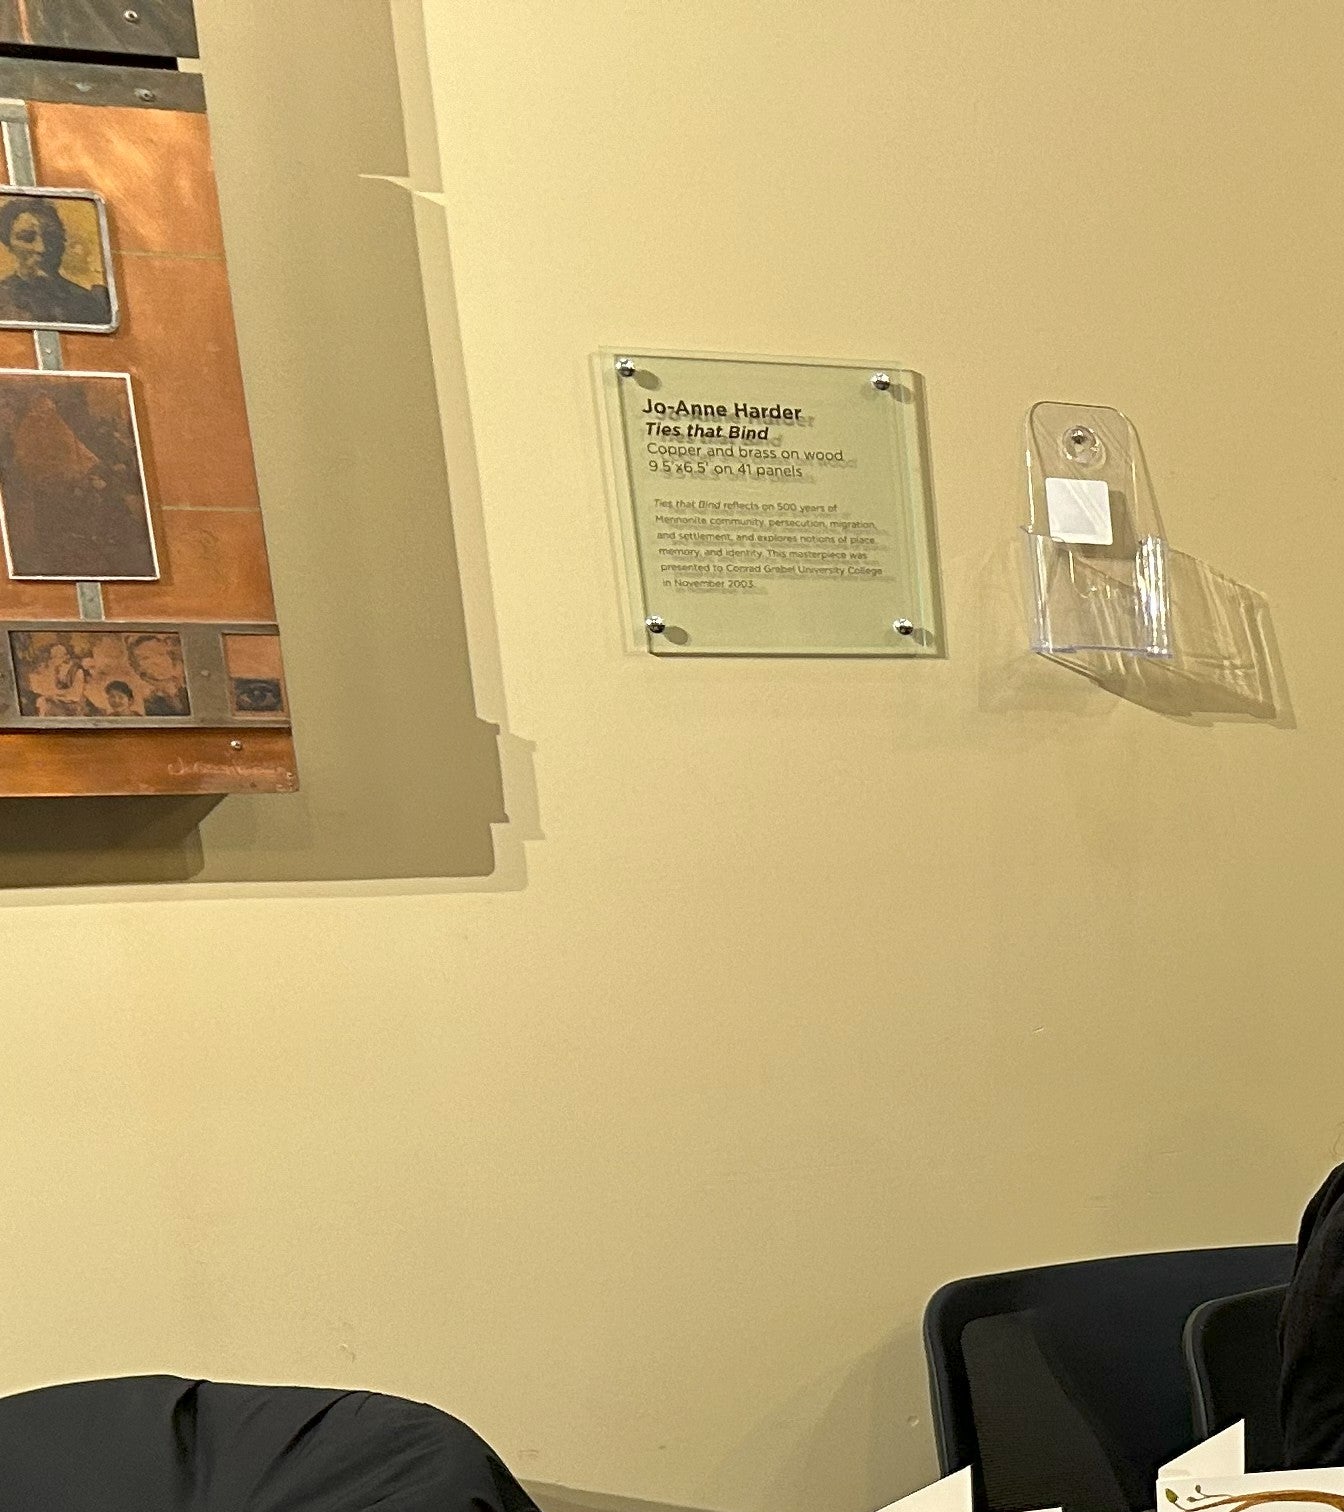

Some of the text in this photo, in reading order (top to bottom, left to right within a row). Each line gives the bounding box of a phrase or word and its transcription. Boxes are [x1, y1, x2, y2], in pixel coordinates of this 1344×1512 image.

[641, 398, 802, 420] Jo-Anne Harder
[645, 421, 770, 440] Ties that Bind
[647, 443, 844, 461] Copper and brass on wood
[714, 464, 733, 475] on
[737, 464, 752, 475] 41
[756, 465, 803, 481] panels
[676, 500, 696, 509] that
[723, 500, 759, 510] reflects
[761, 503, 775, 511] on
[776, 502, 797, 511] 500
[799, 504, 826, 514] years
[827, 504, 838, 512] of
[655, 515, 706, 524] Mennonite
[657, 532, 676, 540] and
[736, 533, 755, 542] and
[757, 535, 797, 543] explores
[837, 535, 848, 544] of
[704, 548, 723, 557] and
[766, 549, 787, 558] This
[789, 551, 847, 560] masterpiece
[849, 552, 867, 560] was
[660, 564, 710, 572] presented
[713, 564, 724, 572] to
[725, 564, 761, 573] Conrad
[797, 565, 845, 576] University
[847, 566, 883, 576] College
[674, 579, 725, 588] November
